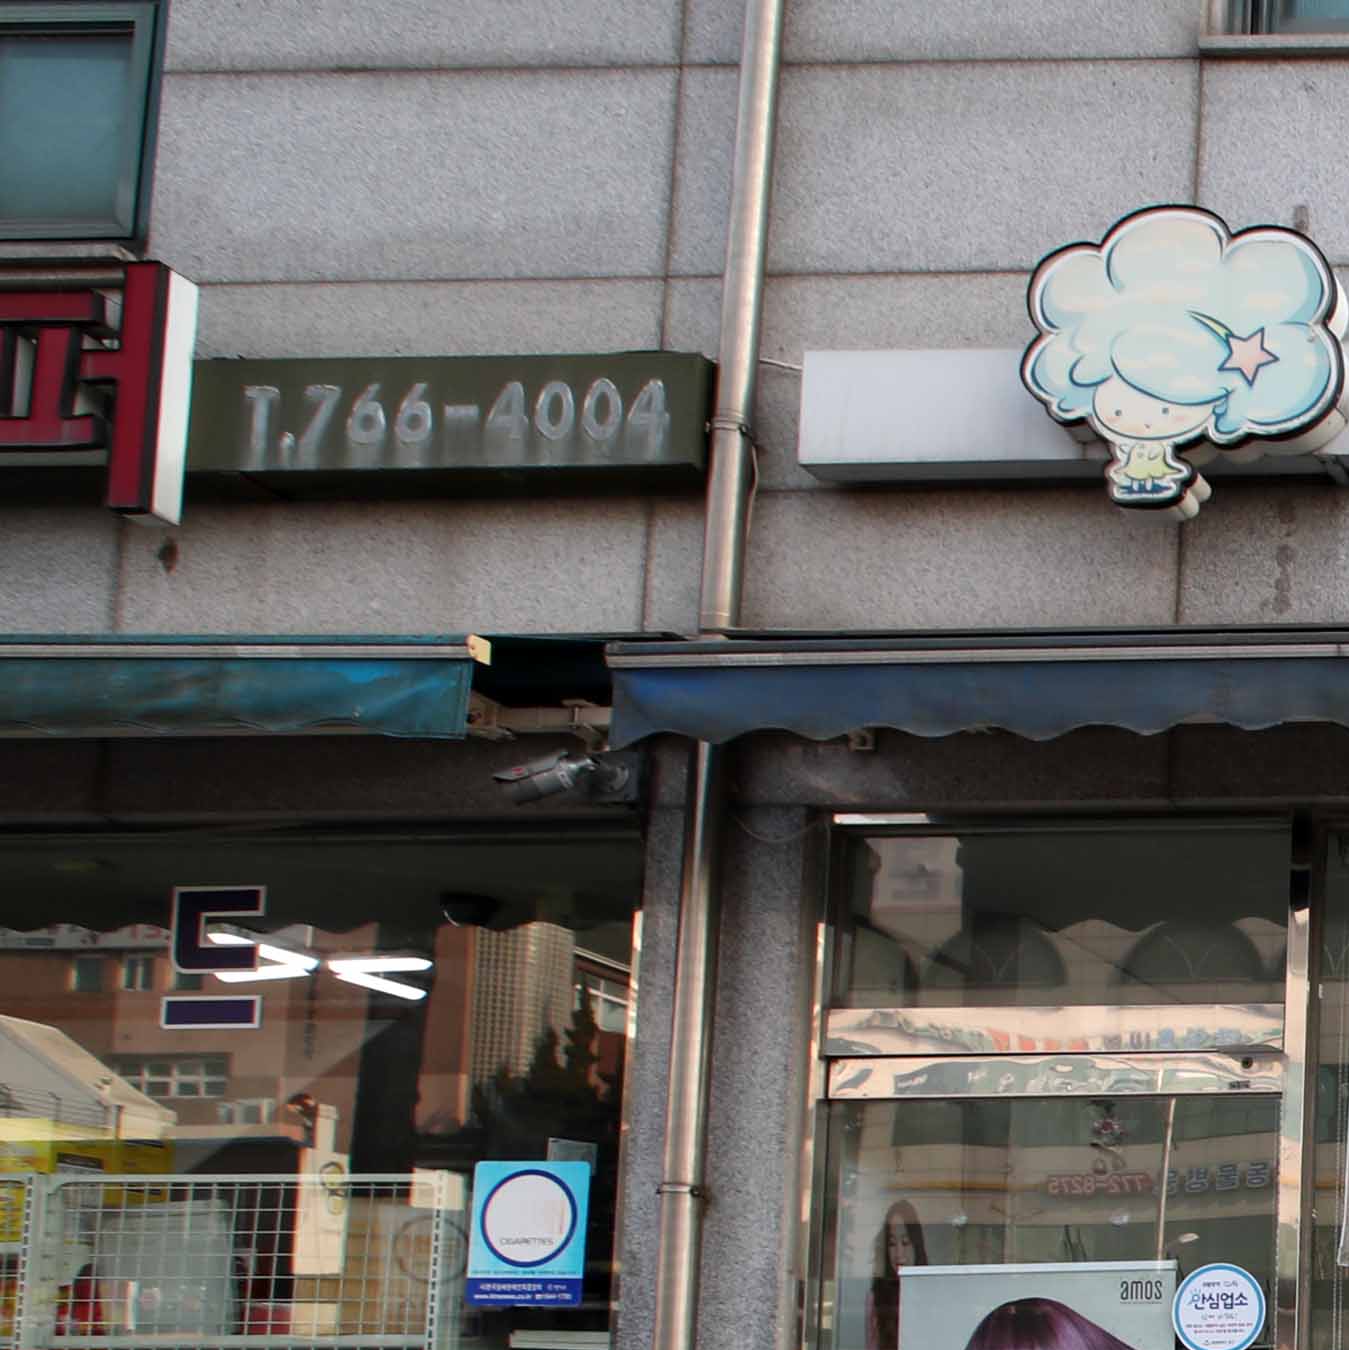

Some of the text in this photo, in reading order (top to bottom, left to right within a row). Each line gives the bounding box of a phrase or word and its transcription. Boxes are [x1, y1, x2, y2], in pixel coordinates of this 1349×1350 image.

[244, 377, 670, 446] T.766-4004
[1120, 1279, 1162, 1301] amos
[1188, 1291, 1249, 1310] 안심업소
